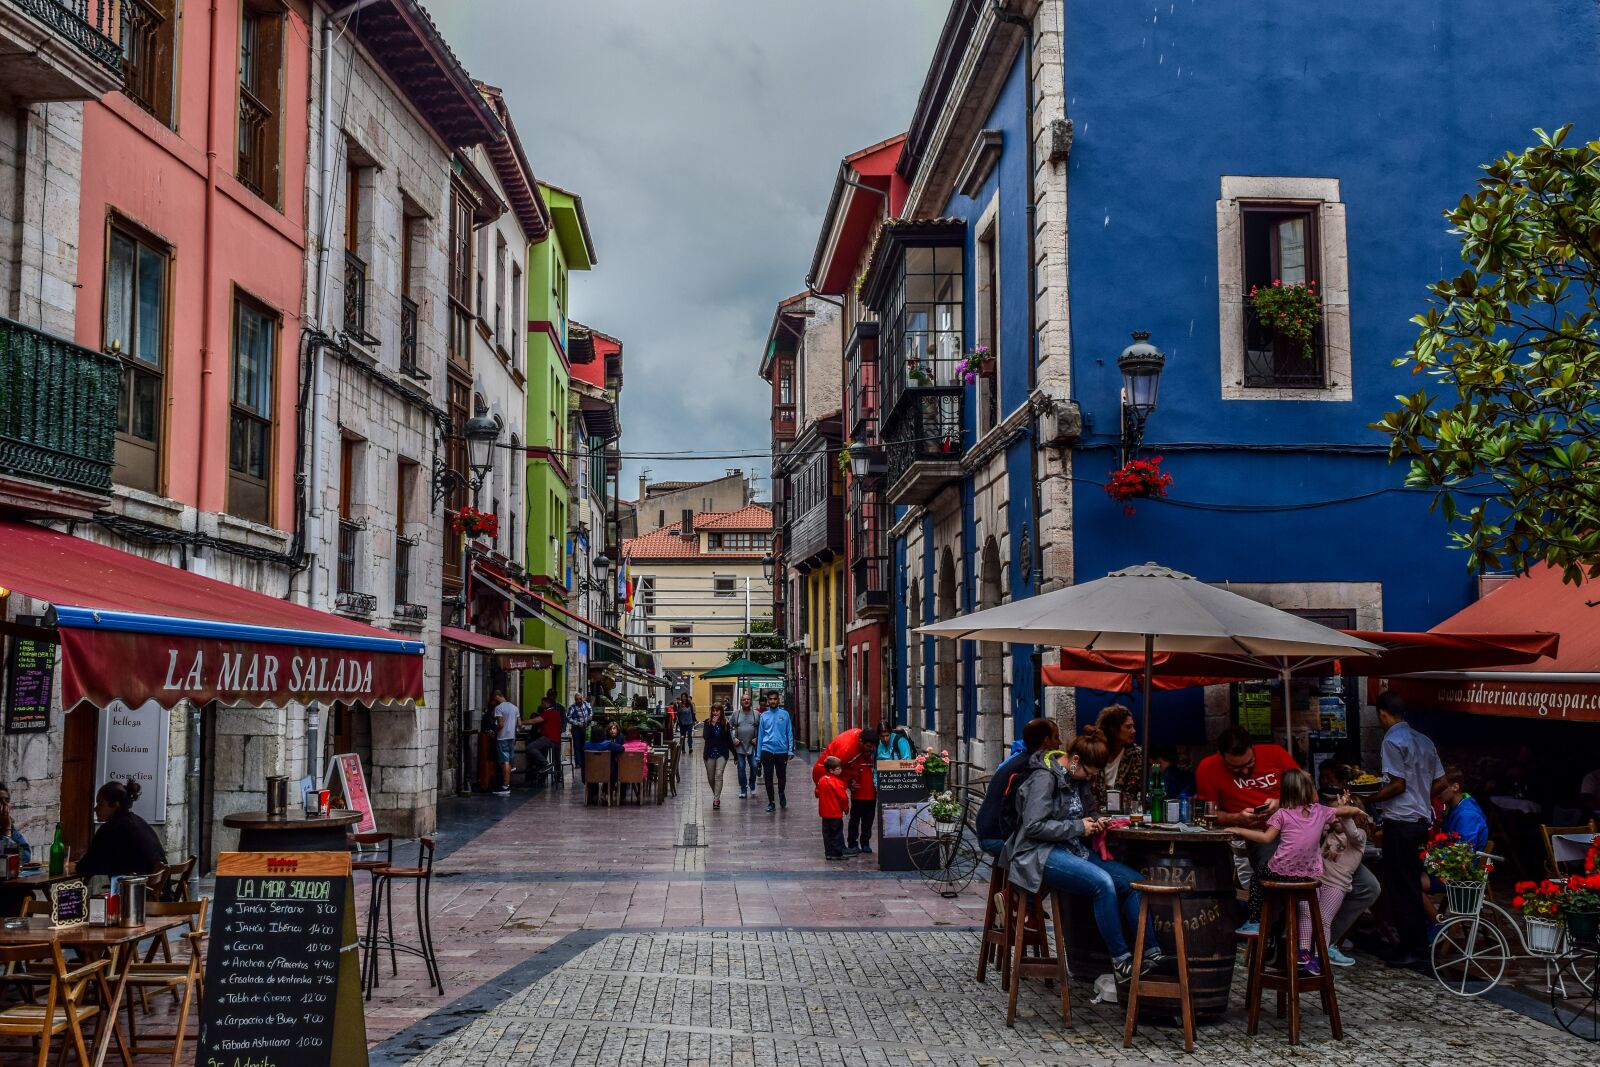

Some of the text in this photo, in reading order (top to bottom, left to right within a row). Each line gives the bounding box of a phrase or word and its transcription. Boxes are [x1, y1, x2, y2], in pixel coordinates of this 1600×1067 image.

[164, 650, 372, 693] LA MAR SALADA
[114, 703, 122, 712] de
[236, 879, 330, 899] LA MAR SALADA
[270, 902, 304, 914] Serrano
[269, 922, 302, 932] Ibérico
[229, 974, 264, 984] Ensalada
[266, 975, 275, 984] de
[250, 993, 262, 1002] de
[224, 1014, 264, 1028] Carpaccio
[265, 1015, 275, 1024] de
[276, 1012, 298, 1025] Buey
[222, 1040, 250, 1050] Fabada
[252, 1037, 291, 1048] Asturiana
